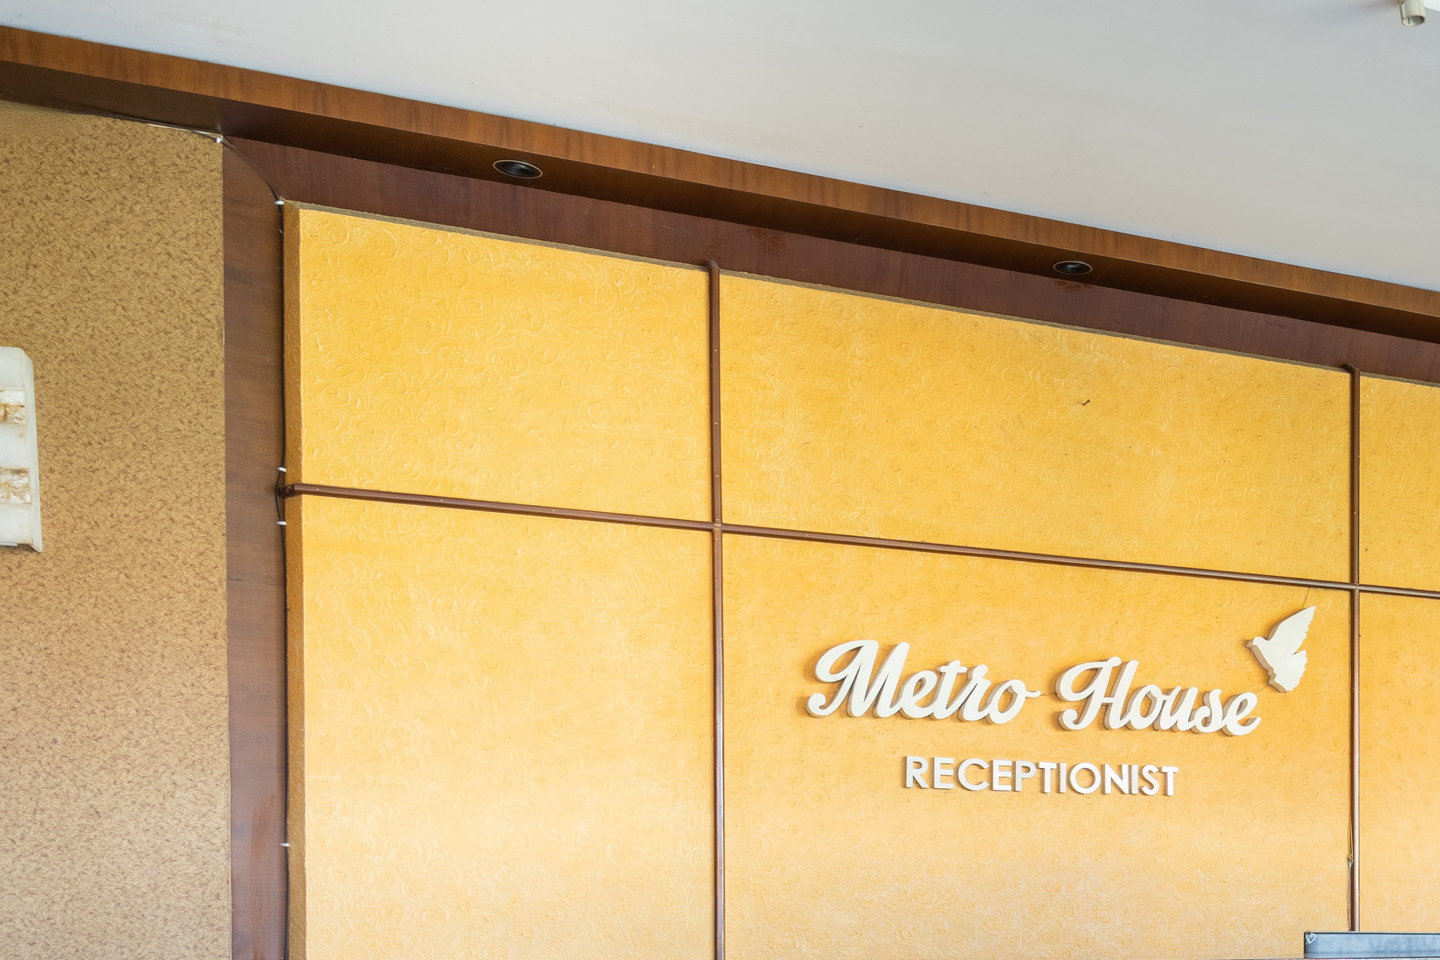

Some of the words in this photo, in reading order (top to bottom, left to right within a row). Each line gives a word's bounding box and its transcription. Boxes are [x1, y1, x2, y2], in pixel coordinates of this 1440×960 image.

[806, 639, 1041, 726] Metro
[1055, 656, 1262, 737] House
[903, 755, 1179, 796] RECEPTIONIST
